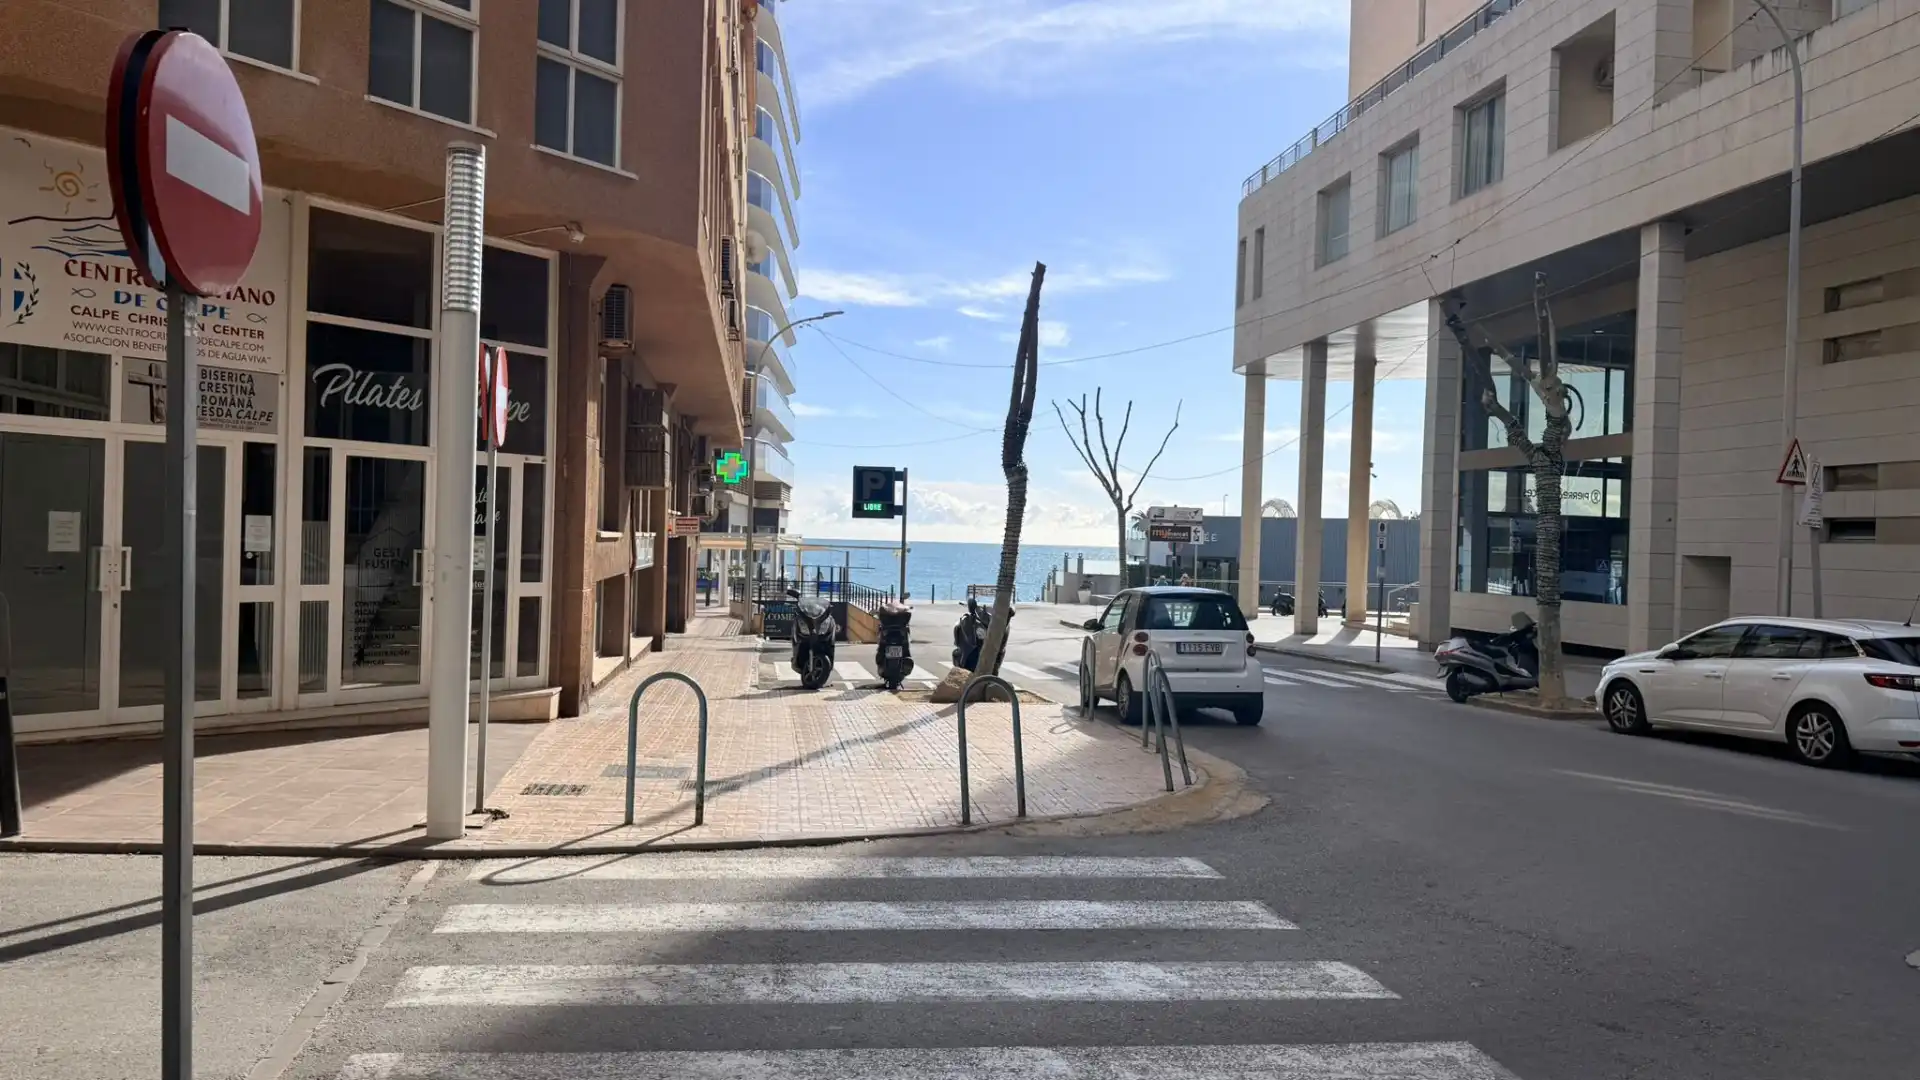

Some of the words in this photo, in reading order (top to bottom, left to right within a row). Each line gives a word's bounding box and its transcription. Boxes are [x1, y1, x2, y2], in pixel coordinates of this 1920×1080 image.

[64, 258, 152, 288] CENTR
[114, 290, 147, 308] DE
[70, 305, 120, 321] CALPE
[128, 313, 205, 332] CHRISN
[212, 323, 265, 340] CENTER
[63, 332, 130, 349] ASOCIACION
[208, 350, 221, 359] DE
[221, 351, 246, 362] AGUA
[200, 368, 254, 385] BISERICA
[312, 363, 424, 411] Pilates
[236, 409, 274, 422] CALPE
[862, 471, 886, 499] P
